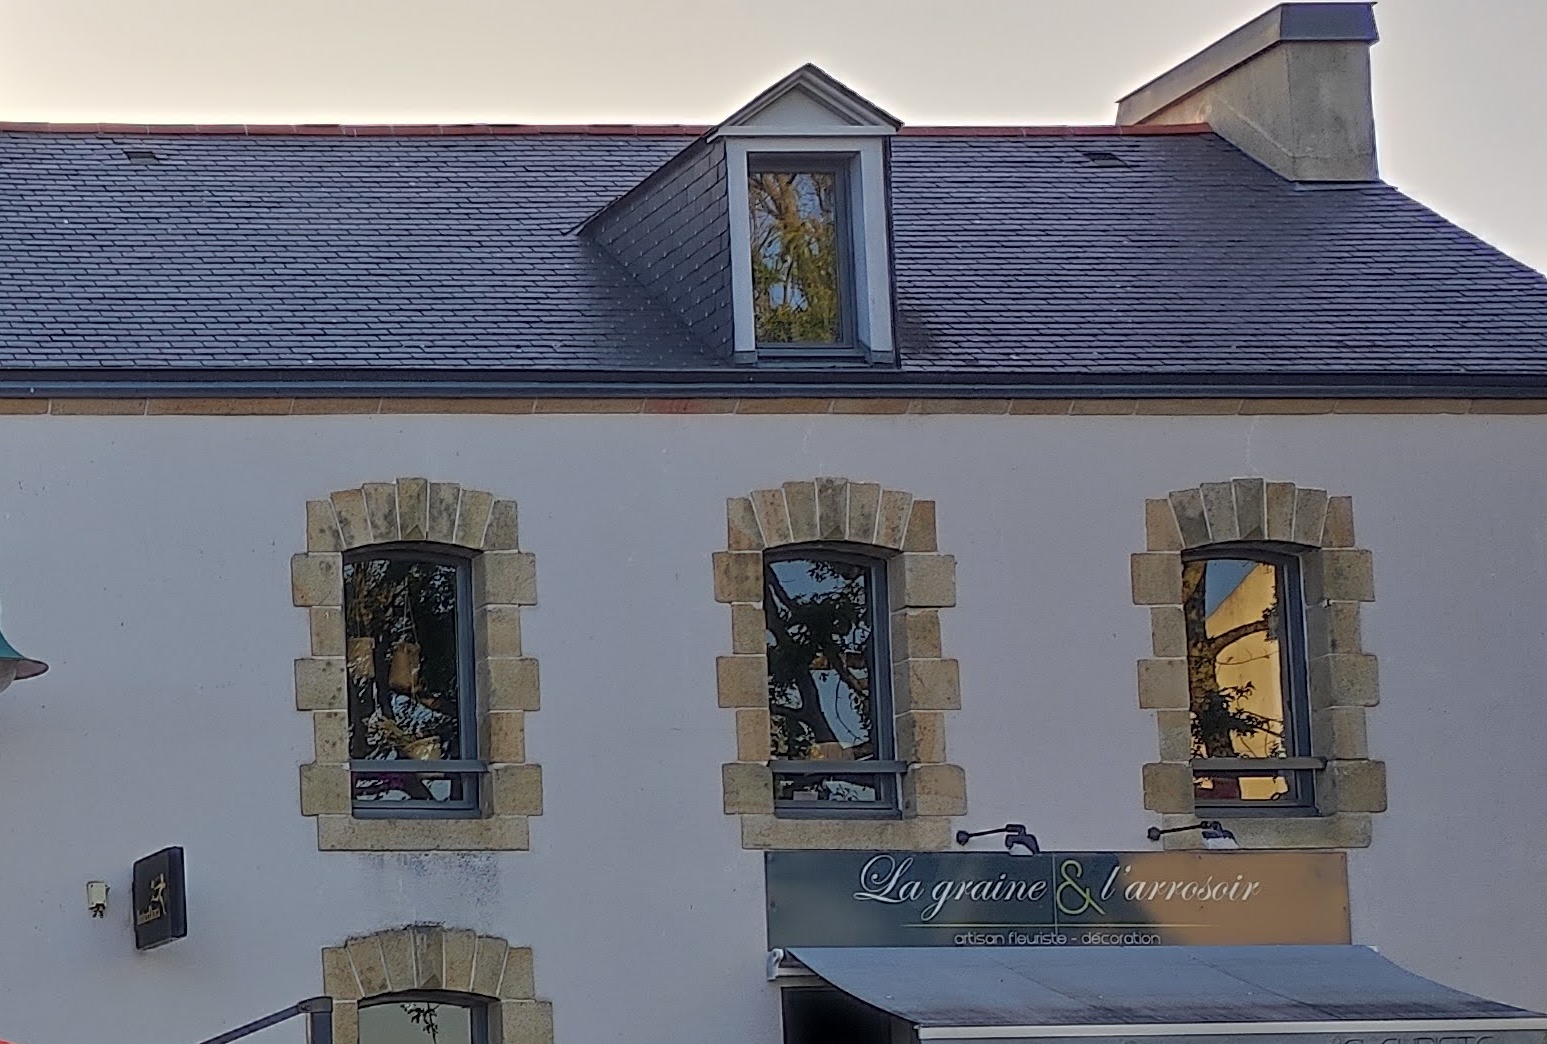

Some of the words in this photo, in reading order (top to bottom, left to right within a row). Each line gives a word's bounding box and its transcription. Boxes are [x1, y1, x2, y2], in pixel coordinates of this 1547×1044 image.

[853, 855, 924, 903] La
[921, 872, 1048, 922] graine
[1056, 859, 1106, 916] &
[1101, 865, 1263, 902] l'arrosoir
[954, 932, 1005, 945] artisan
[1007, 931, 1068, 946] fleuriste
[1081, 931, 1162, 946] décoration
